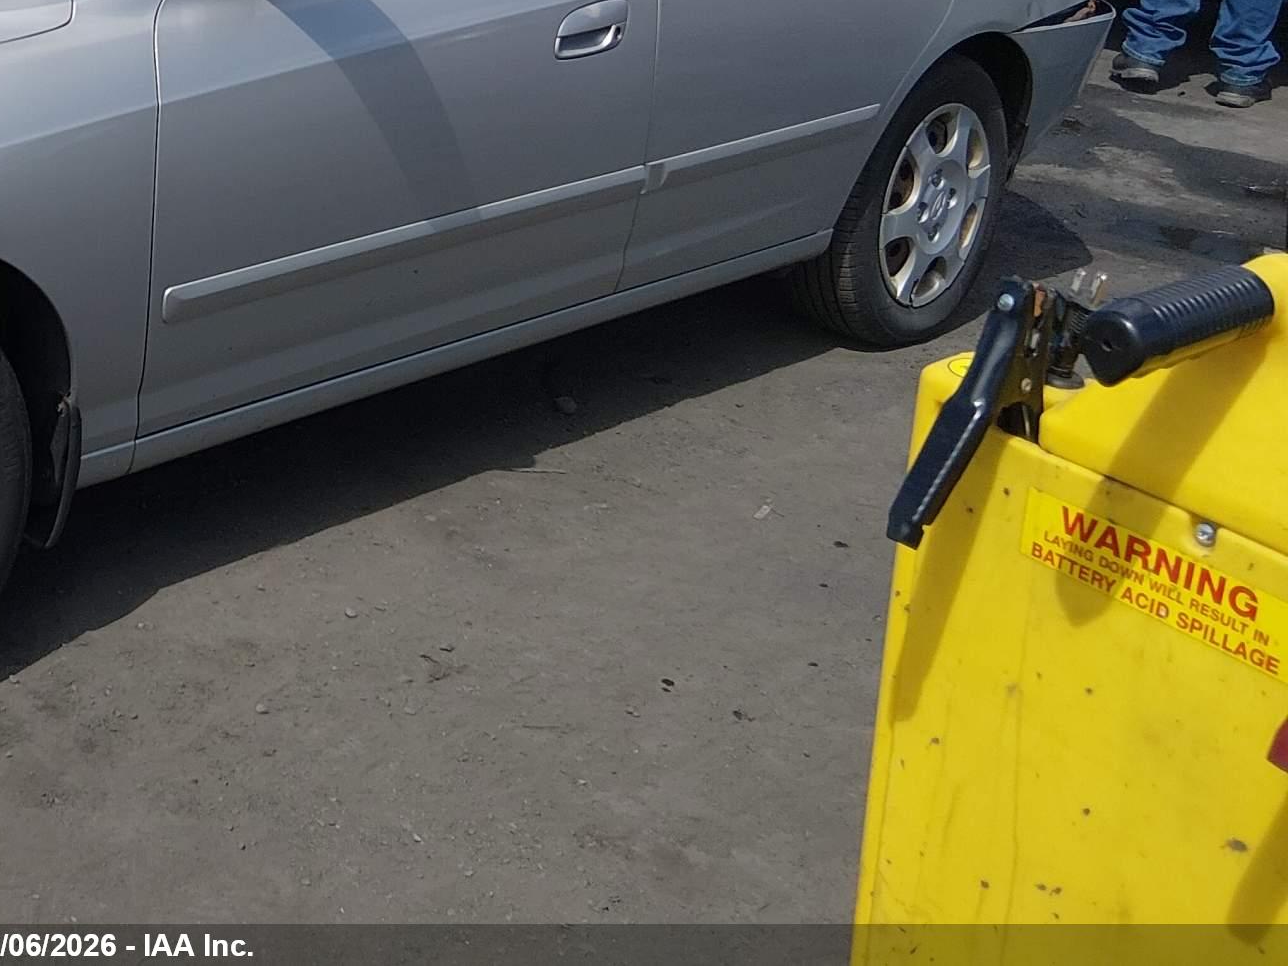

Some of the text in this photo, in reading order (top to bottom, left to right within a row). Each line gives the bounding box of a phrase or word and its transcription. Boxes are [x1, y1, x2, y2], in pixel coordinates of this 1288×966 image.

[1031, 541, 1281, 676] BATTERY ACID SPILLAGE
[1044, 531, 1270, 647] LAYING DOWN WILL RESULT IN
[1062, 506, 1259, 621] WARNING
